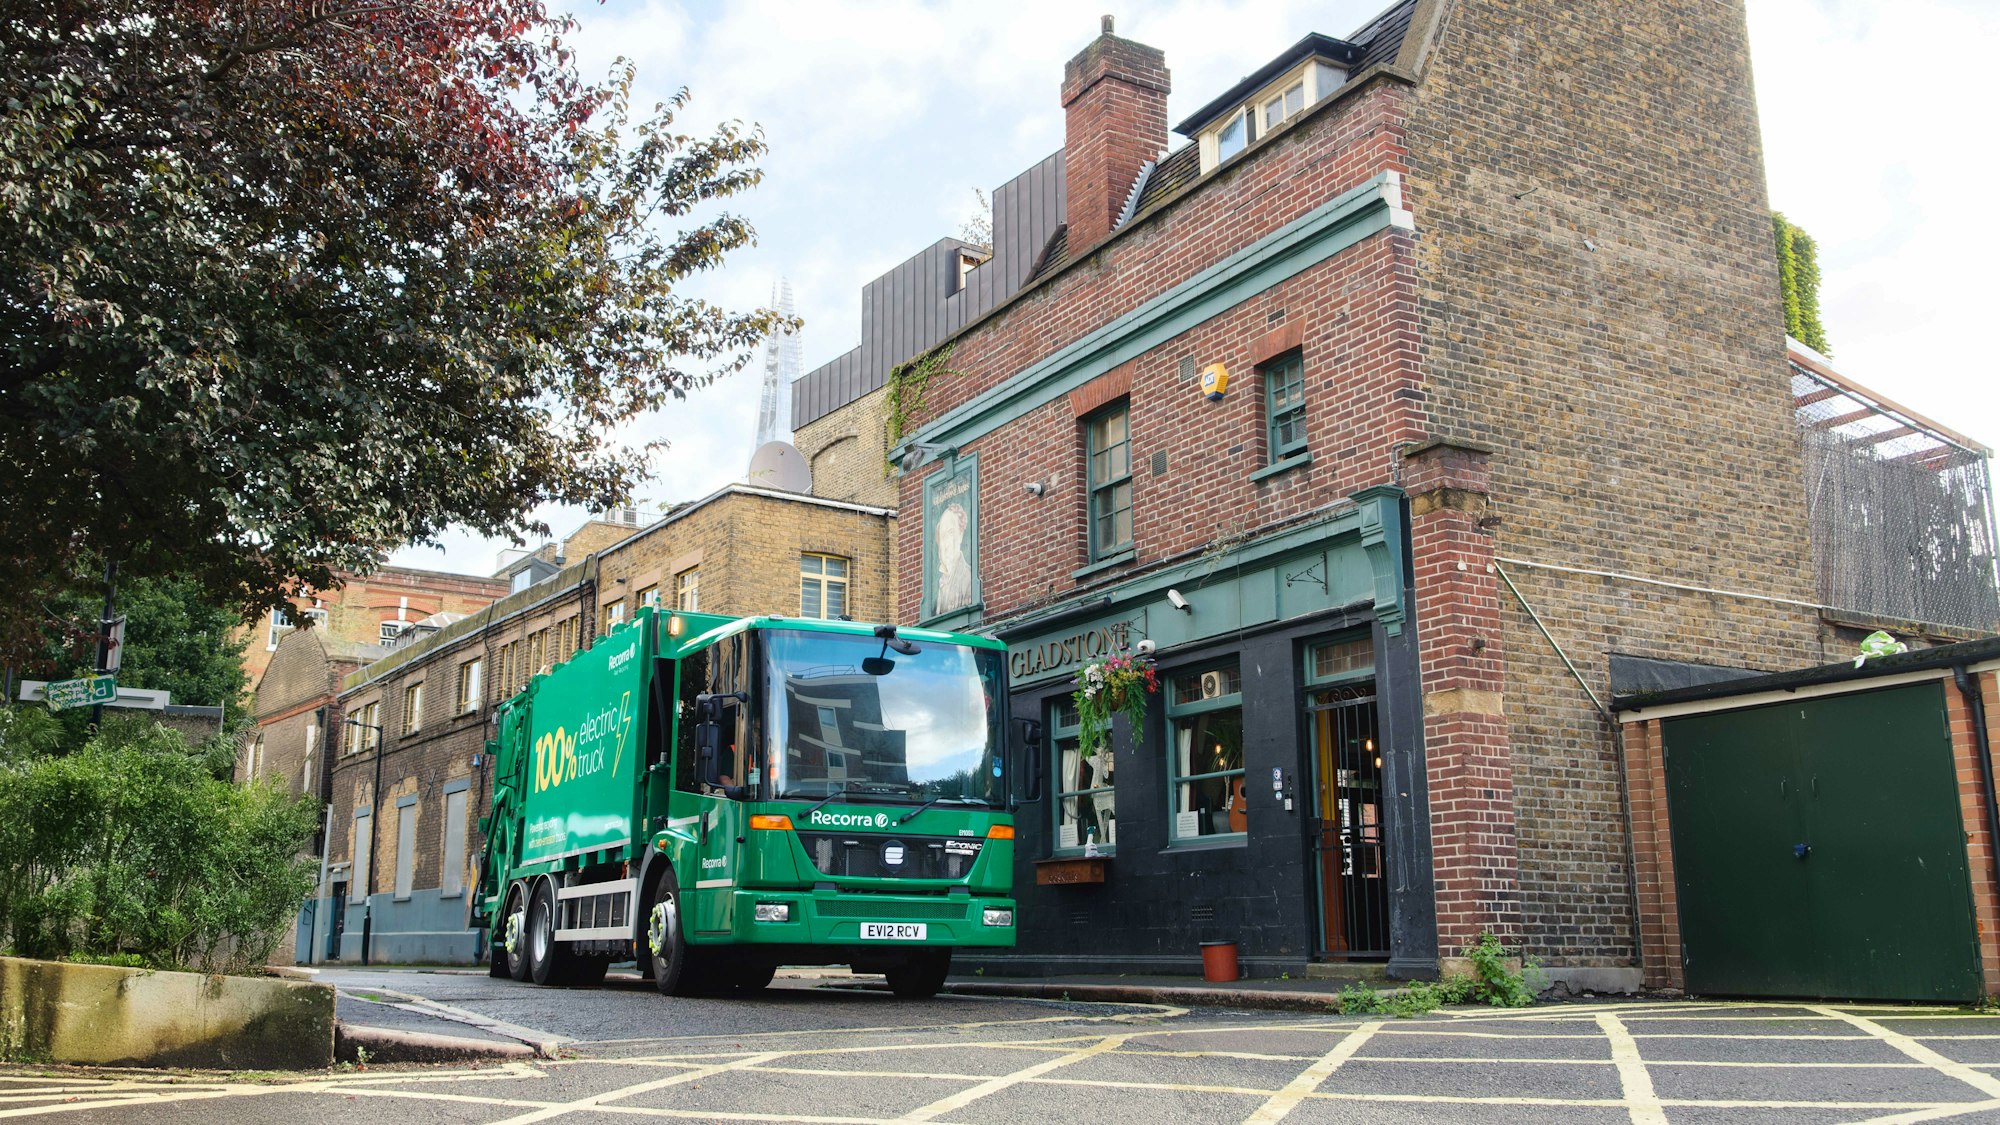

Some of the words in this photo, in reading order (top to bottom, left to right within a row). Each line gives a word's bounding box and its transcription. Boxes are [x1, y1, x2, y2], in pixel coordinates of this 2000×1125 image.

[608, 648, 630, 671] Recorra
[1010, 621, 1130, 678] GLADSTONE
[535, 725, 578, 794] 100%
[580, 702, 617, 745] electric
[578, 739, 605, 777] truck
[811, 810, 873, 827] Recorra
[702, 857, 721, 869] Recorra
[868, 924, 894, 937] EV12
[897, 925, 919, 938] RCV
